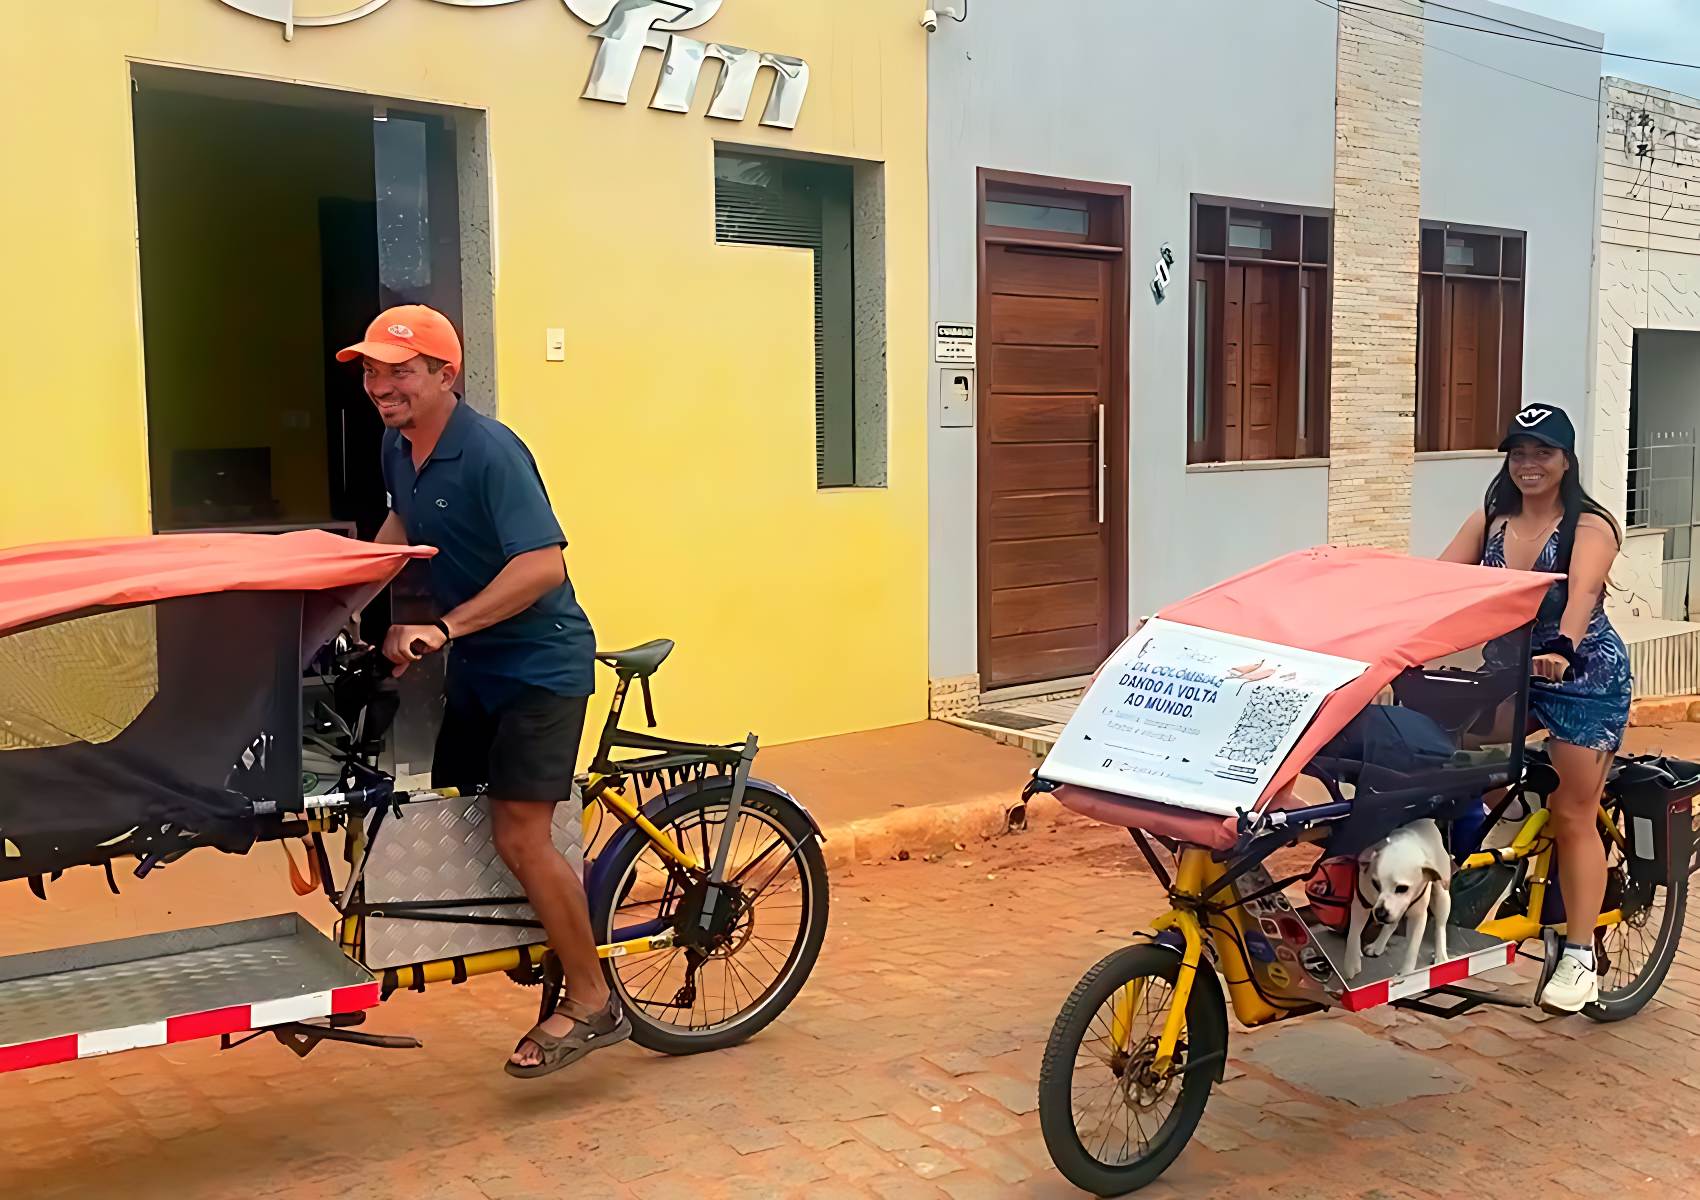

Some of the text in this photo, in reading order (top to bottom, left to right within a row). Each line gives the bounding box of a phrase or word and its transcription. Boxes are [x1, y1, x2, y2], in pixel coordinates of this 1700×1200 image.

[580, 0, 810, 130] fm
[1118, 673, 1218, 704] DANDO A VOLTA
[1123, 692, 1193, 718] AO MUNDO.
